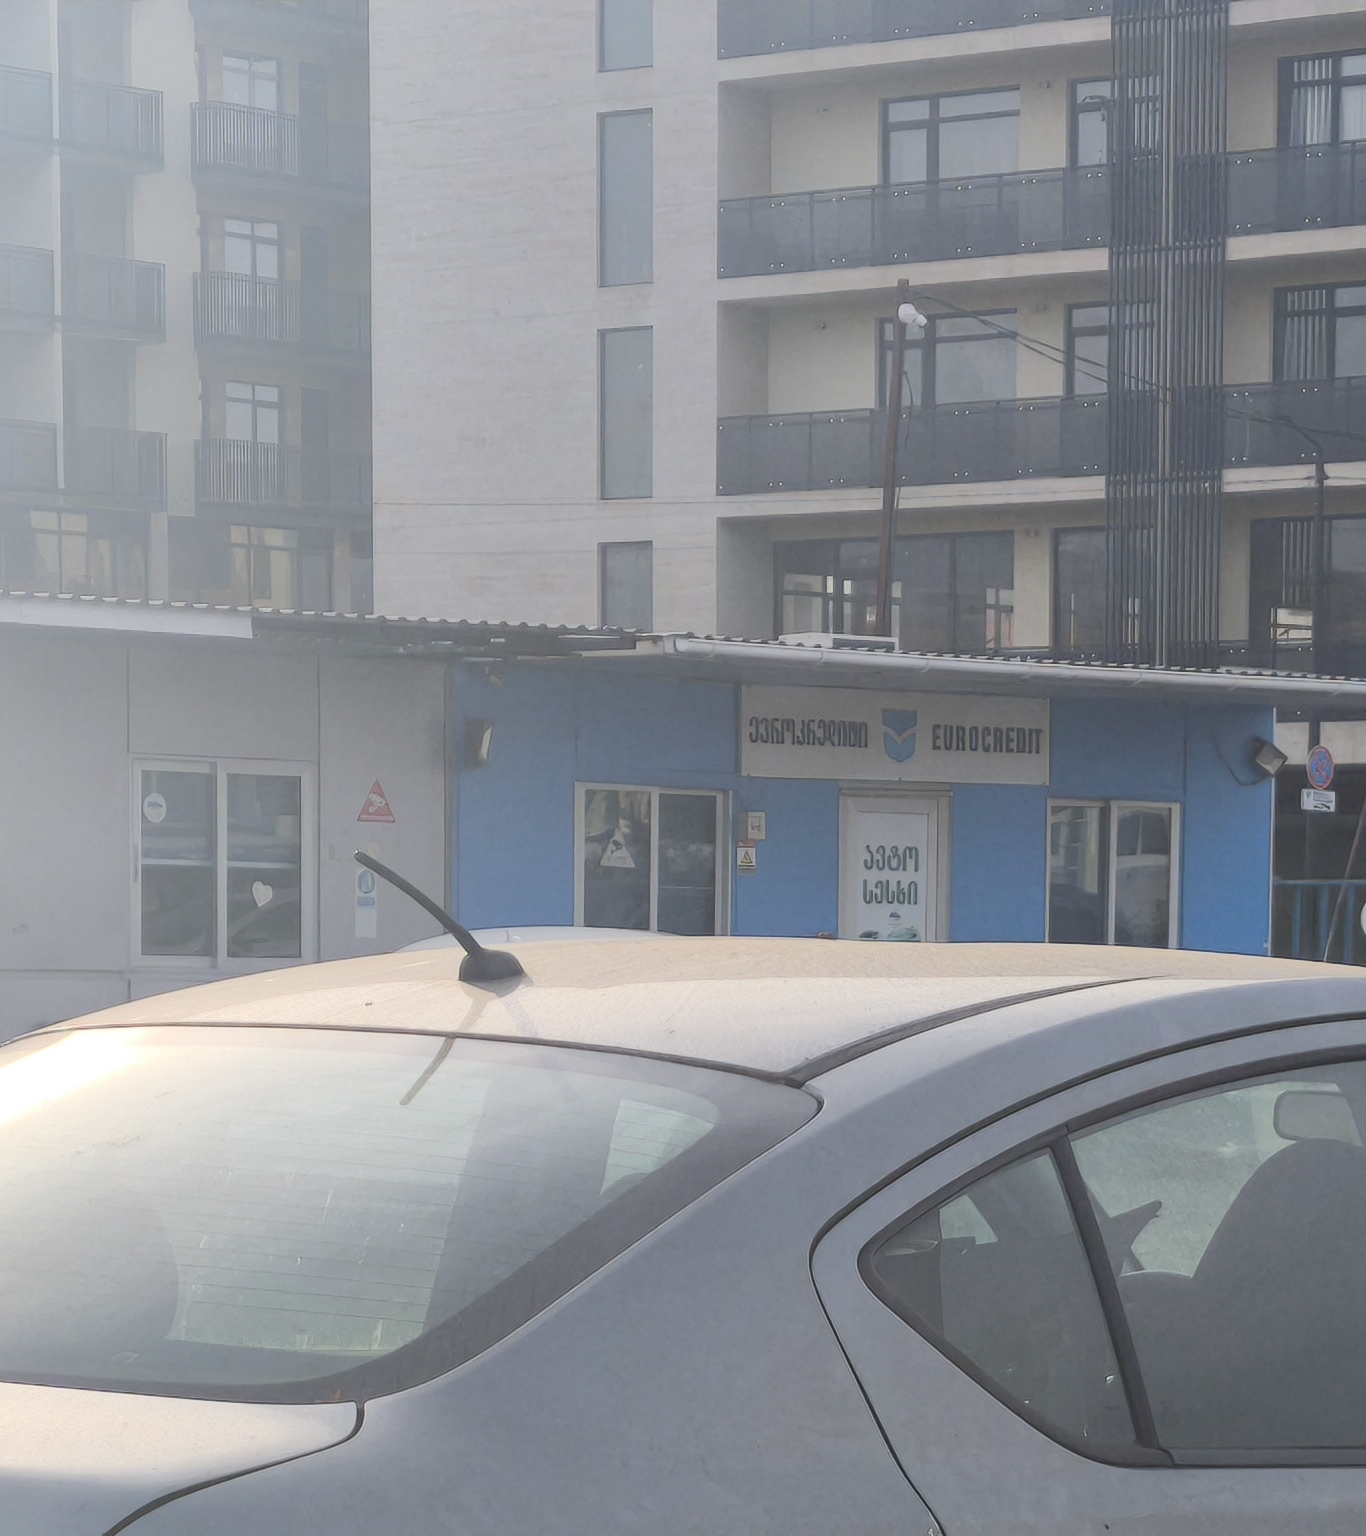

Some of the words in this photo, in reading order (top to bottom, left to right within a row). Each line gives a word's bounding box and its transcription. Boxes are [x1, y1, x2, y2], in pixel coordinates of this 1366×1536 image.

[748, 716, 869, 749] ევროკრედიტი
[931, 723, 1044, 754] EUROCREDIT
[863, 844, 919, 872] ავტო
[862, 879, 918, 905] სესხი
